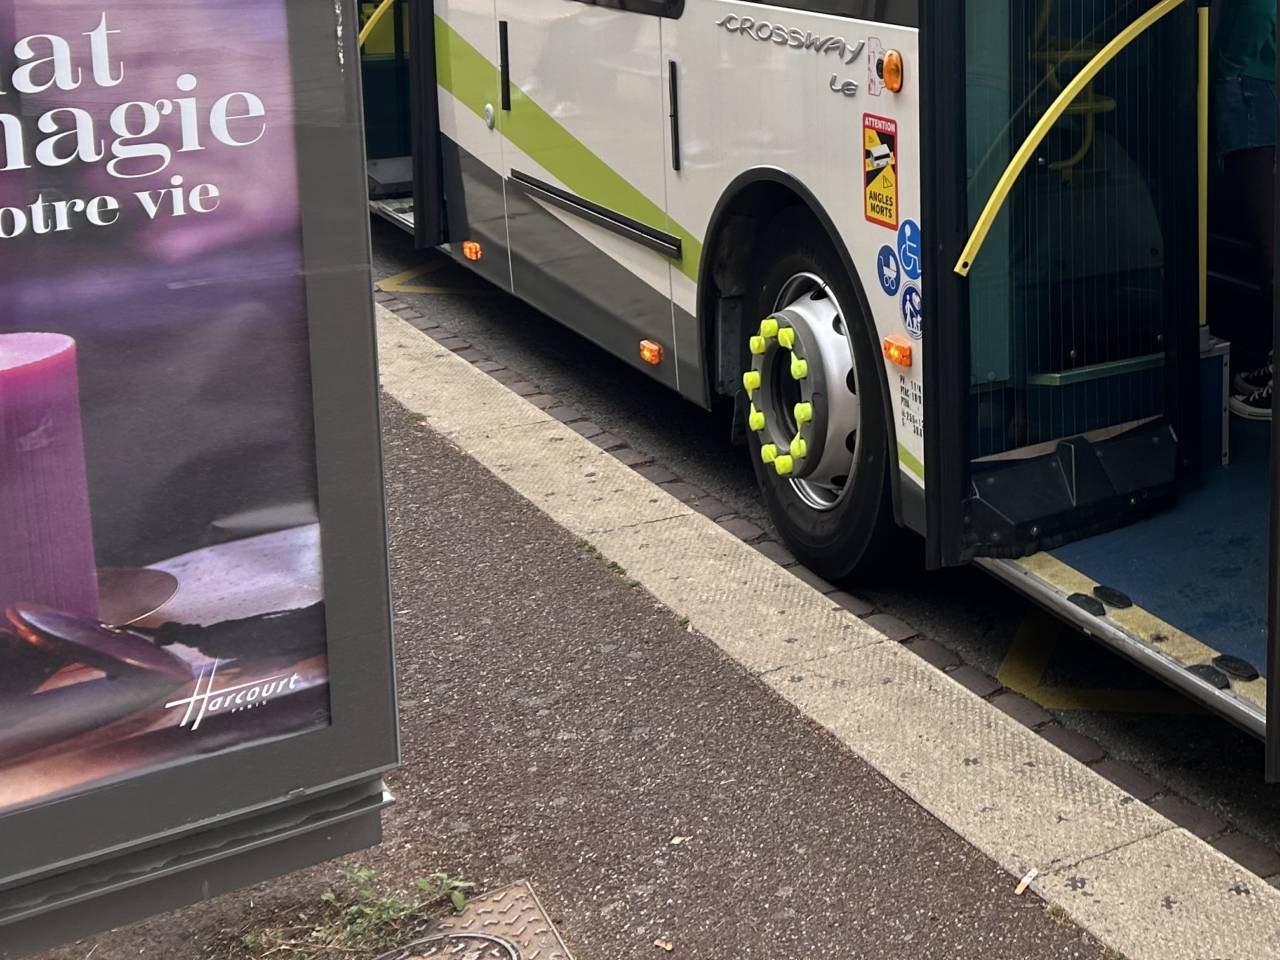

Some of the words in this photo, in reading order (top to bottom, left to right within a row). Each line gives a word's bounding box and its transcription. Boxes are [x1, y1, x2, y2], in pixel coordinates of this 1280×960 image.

[0, 10, 124, 94] at
[715, 13, 865, 64] CROSSWAY
[865, 116, 896, 133] ATTENTION
[134, 175, 220, 219] vie
[869, 190, 894, 207] ANGLES
[870, 203, 892, 219] MORTS
[165, 656, 302, 731] Harcourt
